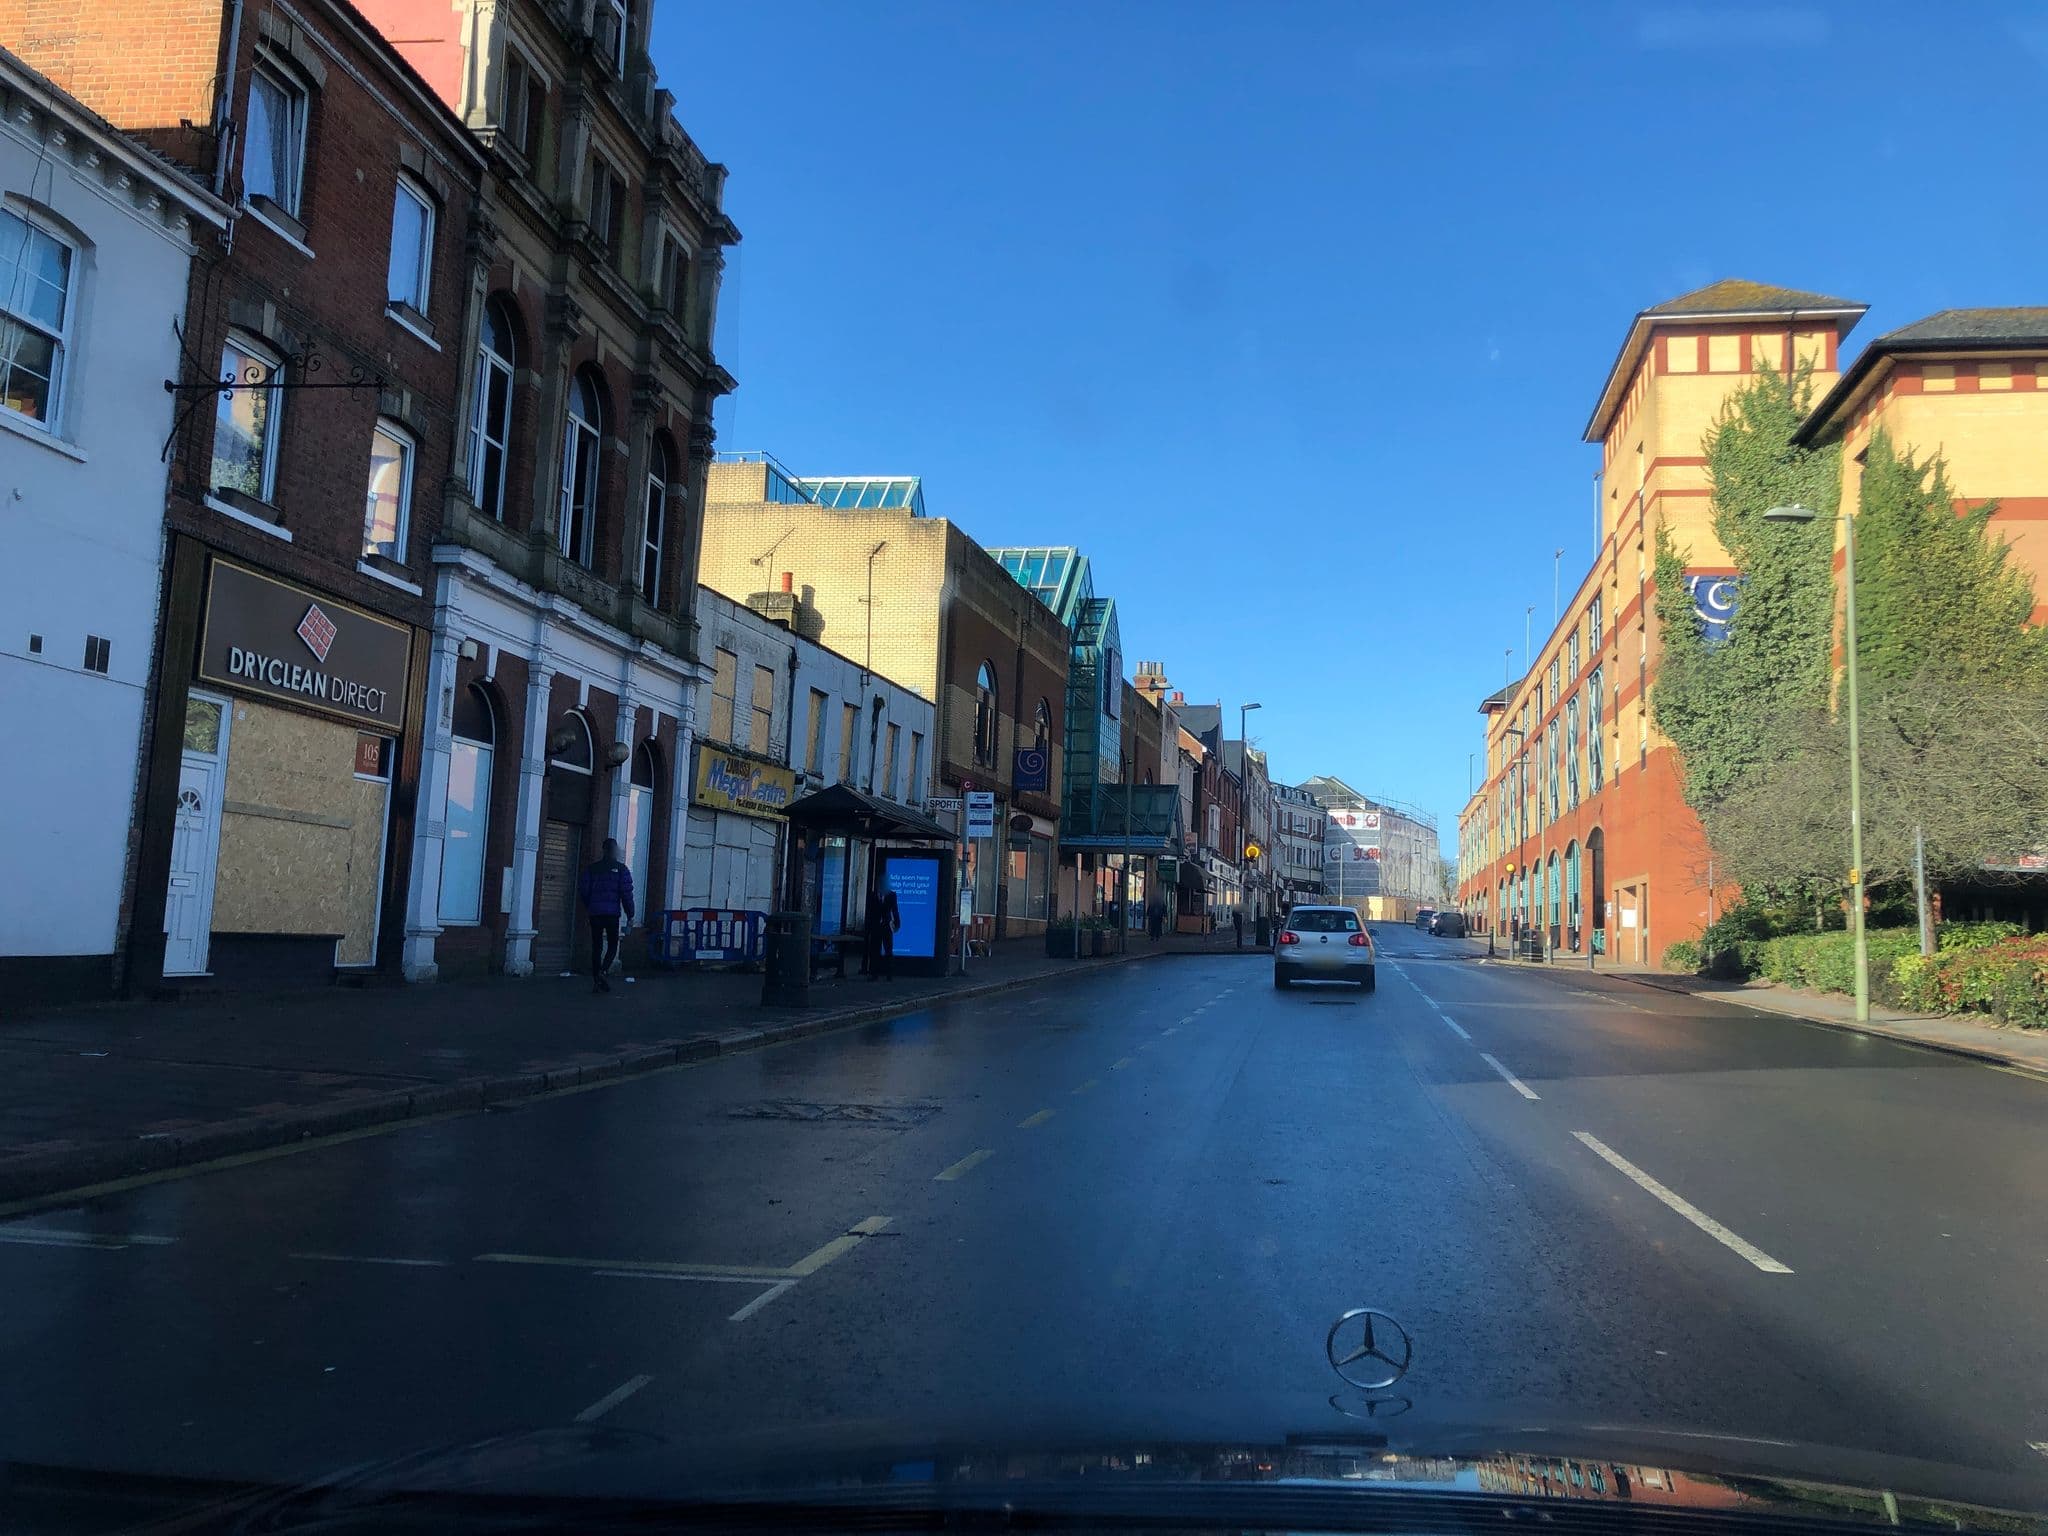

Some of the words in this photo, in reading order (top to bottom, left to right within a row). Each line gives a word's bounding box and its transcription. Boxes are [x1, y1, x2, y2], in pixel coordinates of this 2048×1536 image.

[230, 647, 327, 698] DRYCLEAN
[331, 676, 387, 714] DIRECT
[362, 743, 379, 762] 105
[705, 759, 751, 800] Mega
[750, 768, 787, 804] Centre
[929, 799, 963, 810] SPORTS
